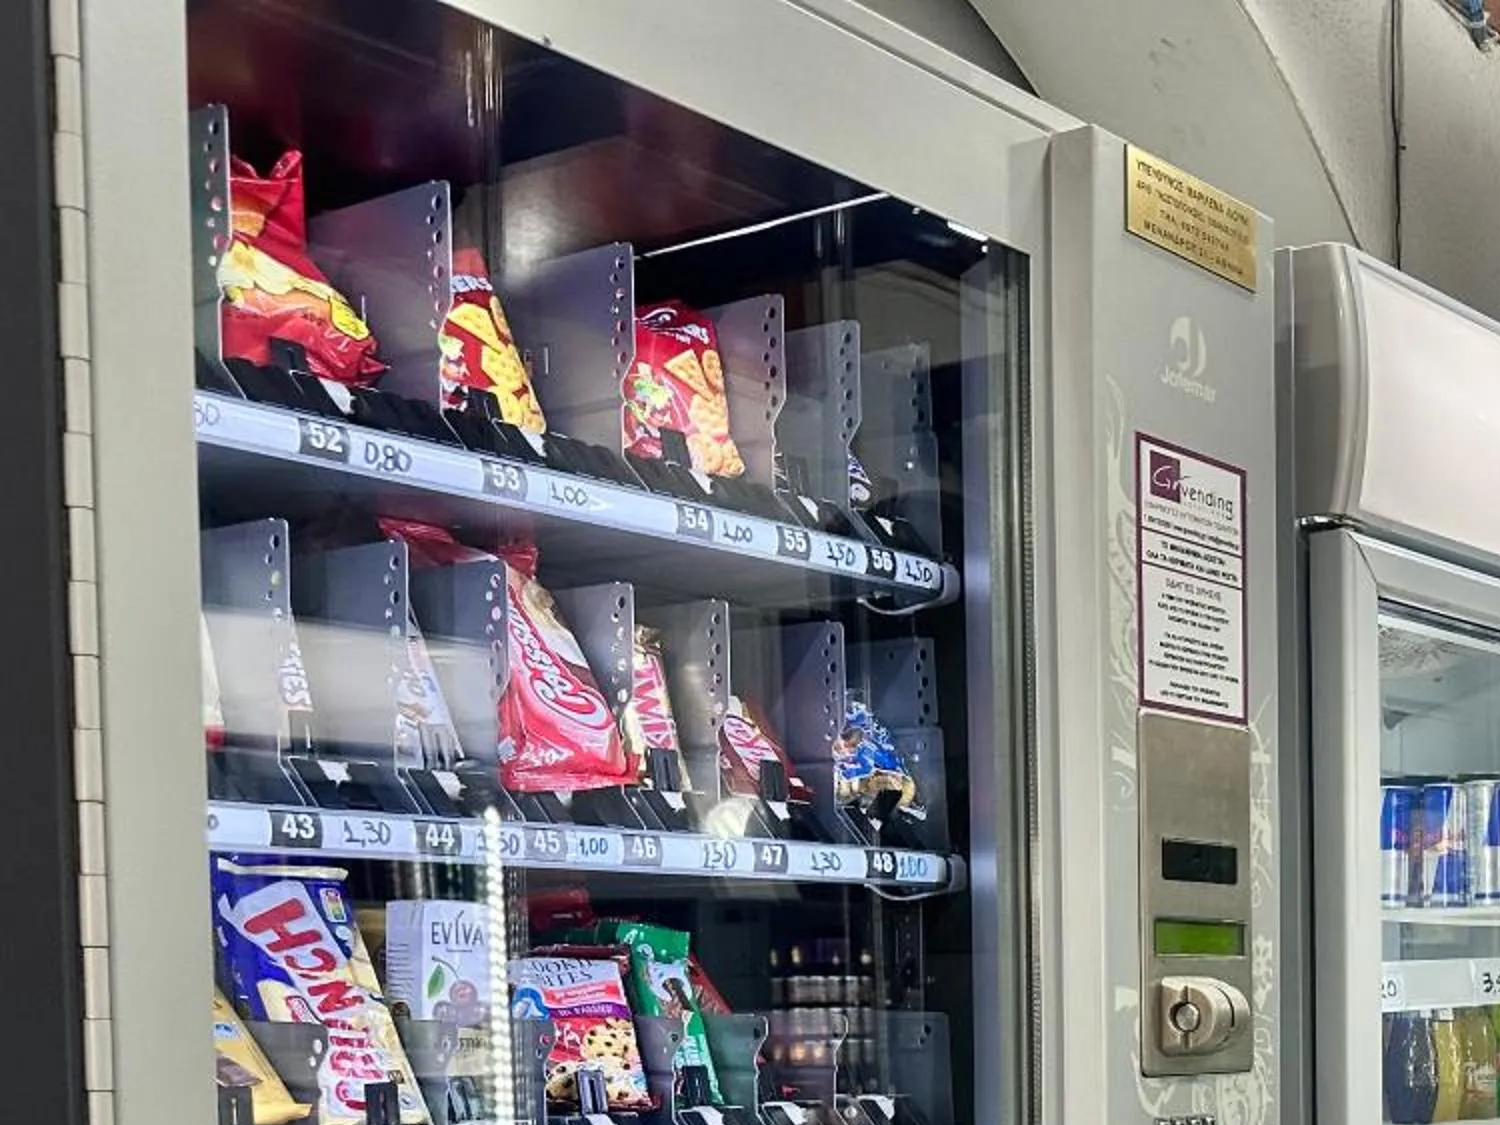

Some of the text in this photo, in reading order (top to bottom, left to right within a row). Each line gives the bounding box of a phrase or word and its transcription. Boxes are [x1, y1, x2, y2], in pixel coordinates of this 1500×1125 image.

[309, 423, 343, 453] 52
[364, 440, 413, 473] 0,80
[490, 464, 520, 492] 53
[684, 508, 708, 532] 54
[784, 529, 807, 553] 55
[870, 549, 894, 571] 56
[281, 813, 316, 840] 43
[343, 820, 392, 849] 1,30
[424, 822, 456, 848] 44
[533, 831, 560, 852] 45
[631, 837, 657, 859] 46
[761, 845, 784, 867] 47
[872, 853, 894, 874] 48
